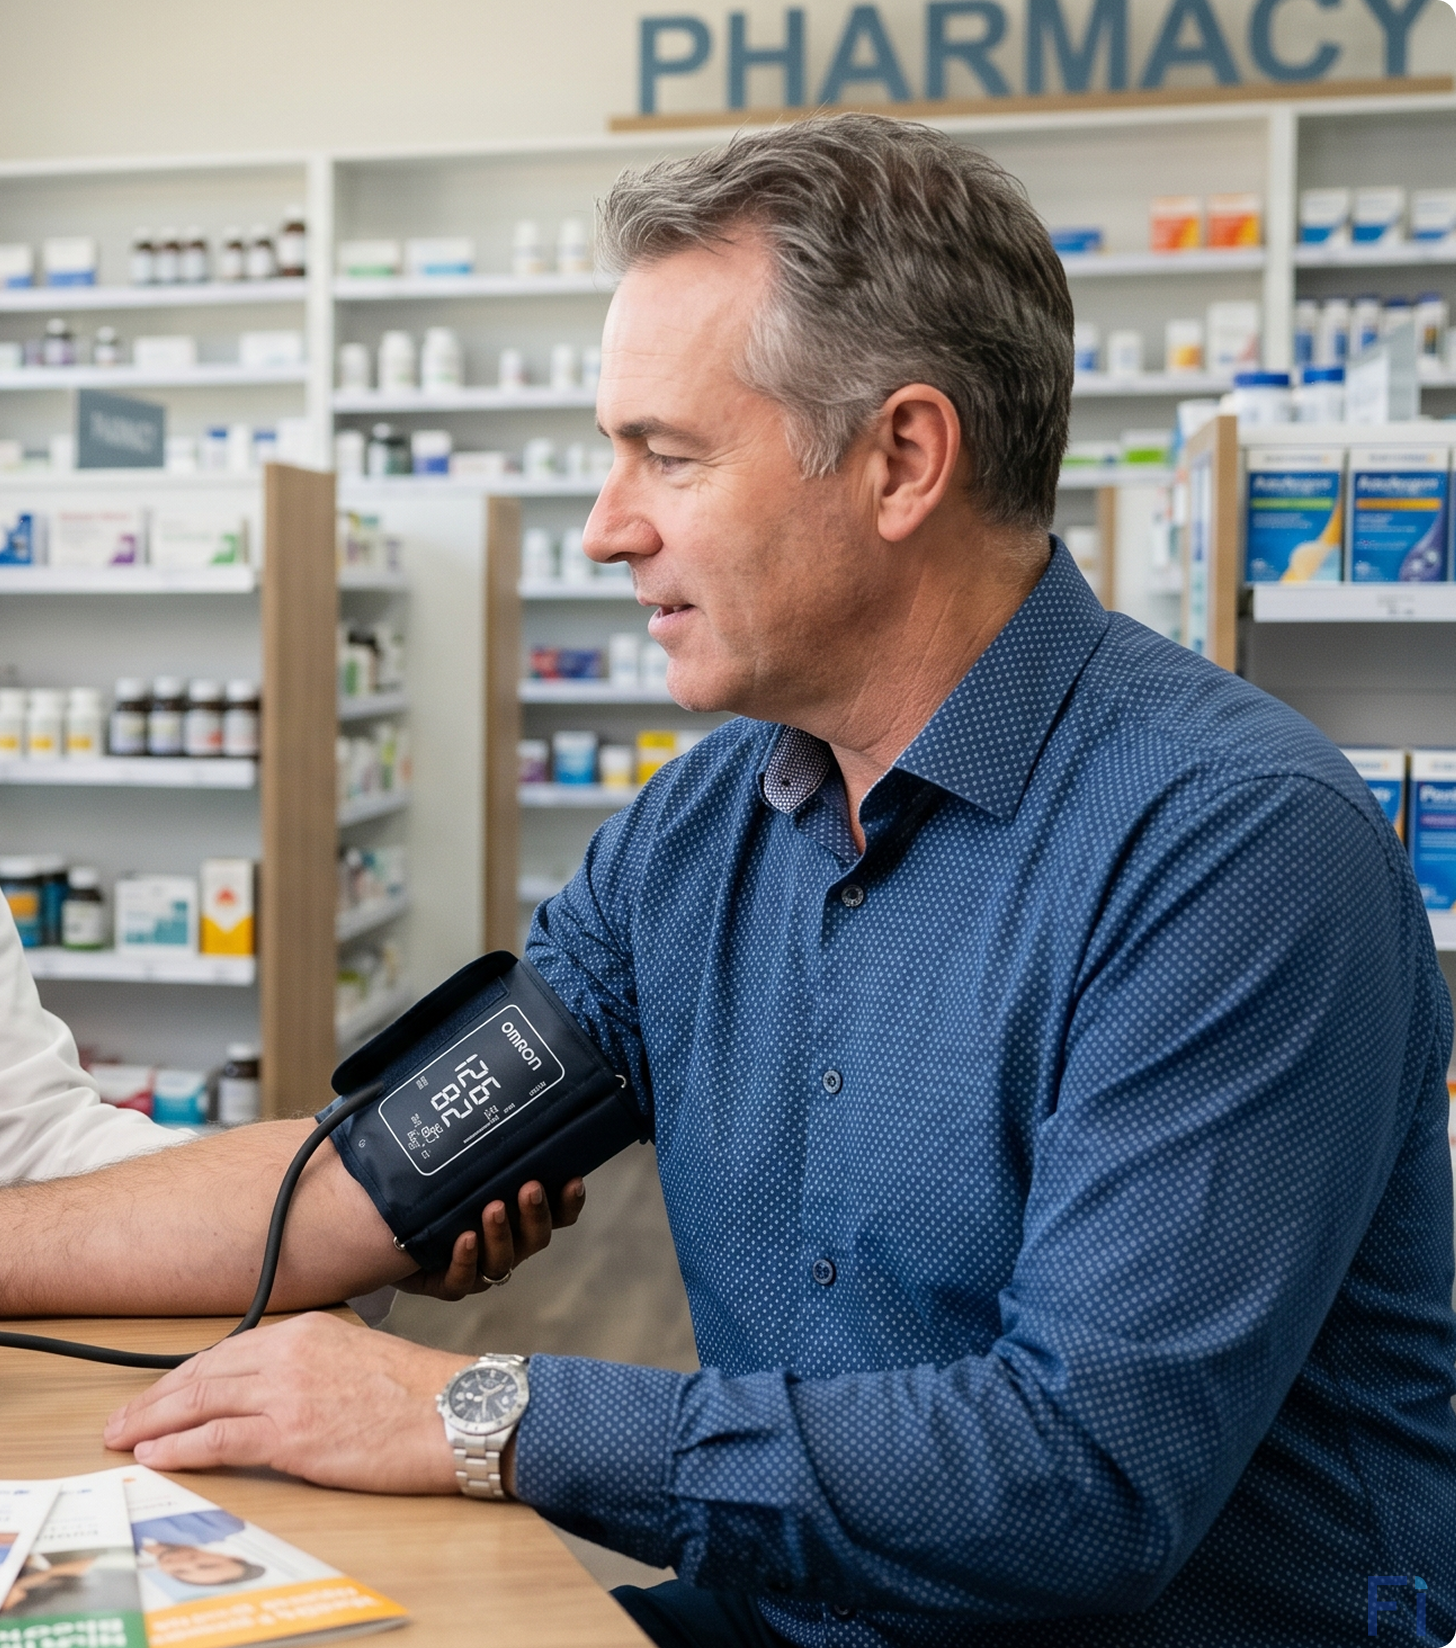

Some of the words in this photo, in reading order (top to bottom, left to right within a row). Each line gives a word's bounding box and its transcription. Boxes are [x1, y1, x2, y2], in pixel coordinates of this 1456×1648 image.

[638, 0, 1431, 116] PHARMACY
[501, 1021, 542, 1071] OMRON
[454, 1053, 501, 1106] 126
[430, 1083, 473, 1128] 82
